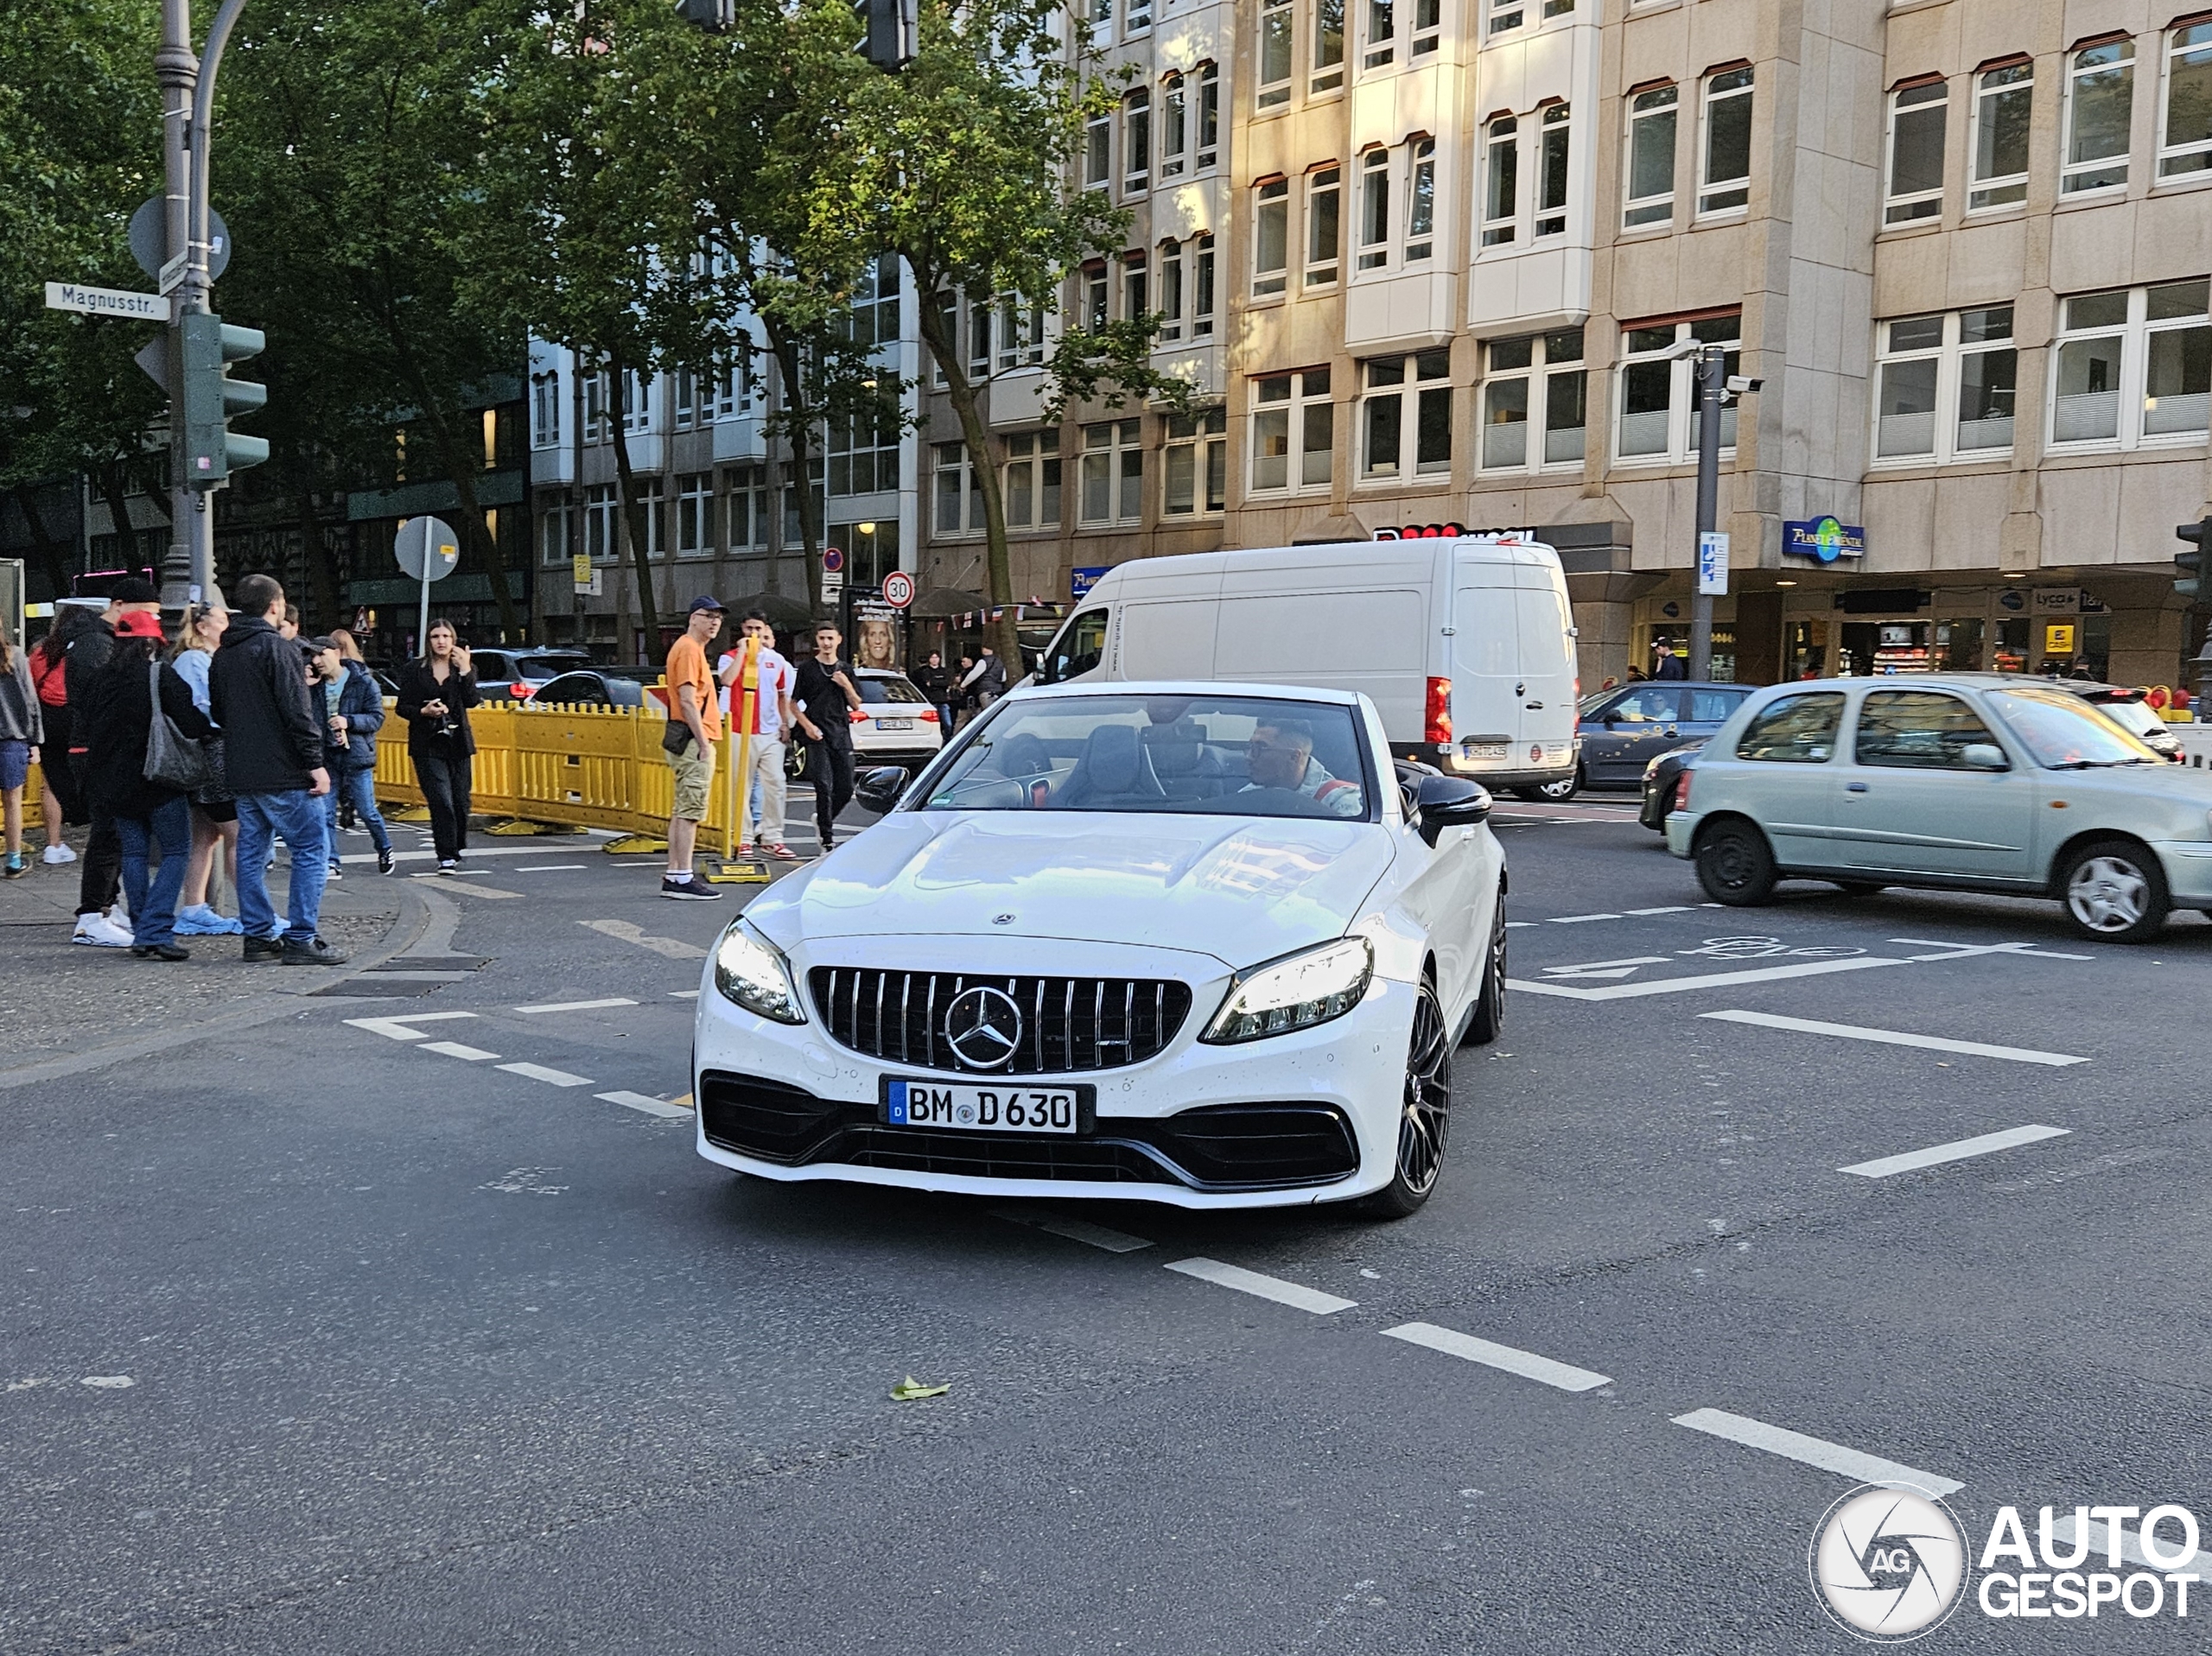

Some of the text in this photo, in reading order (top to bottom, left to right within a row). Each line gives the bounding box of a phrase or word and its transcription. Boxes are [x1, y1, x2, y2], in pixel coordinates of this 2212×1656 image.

[61, 286, 155, 314] Magnusstr.
[889, 582, 906, 598] 30
[2037, 593, 2065, 606] Lyca
[894, 1107, 902, 1117] D
[910, 1088, 952, 1123] BM
[1006, 1093, 1071, 1128] 630
